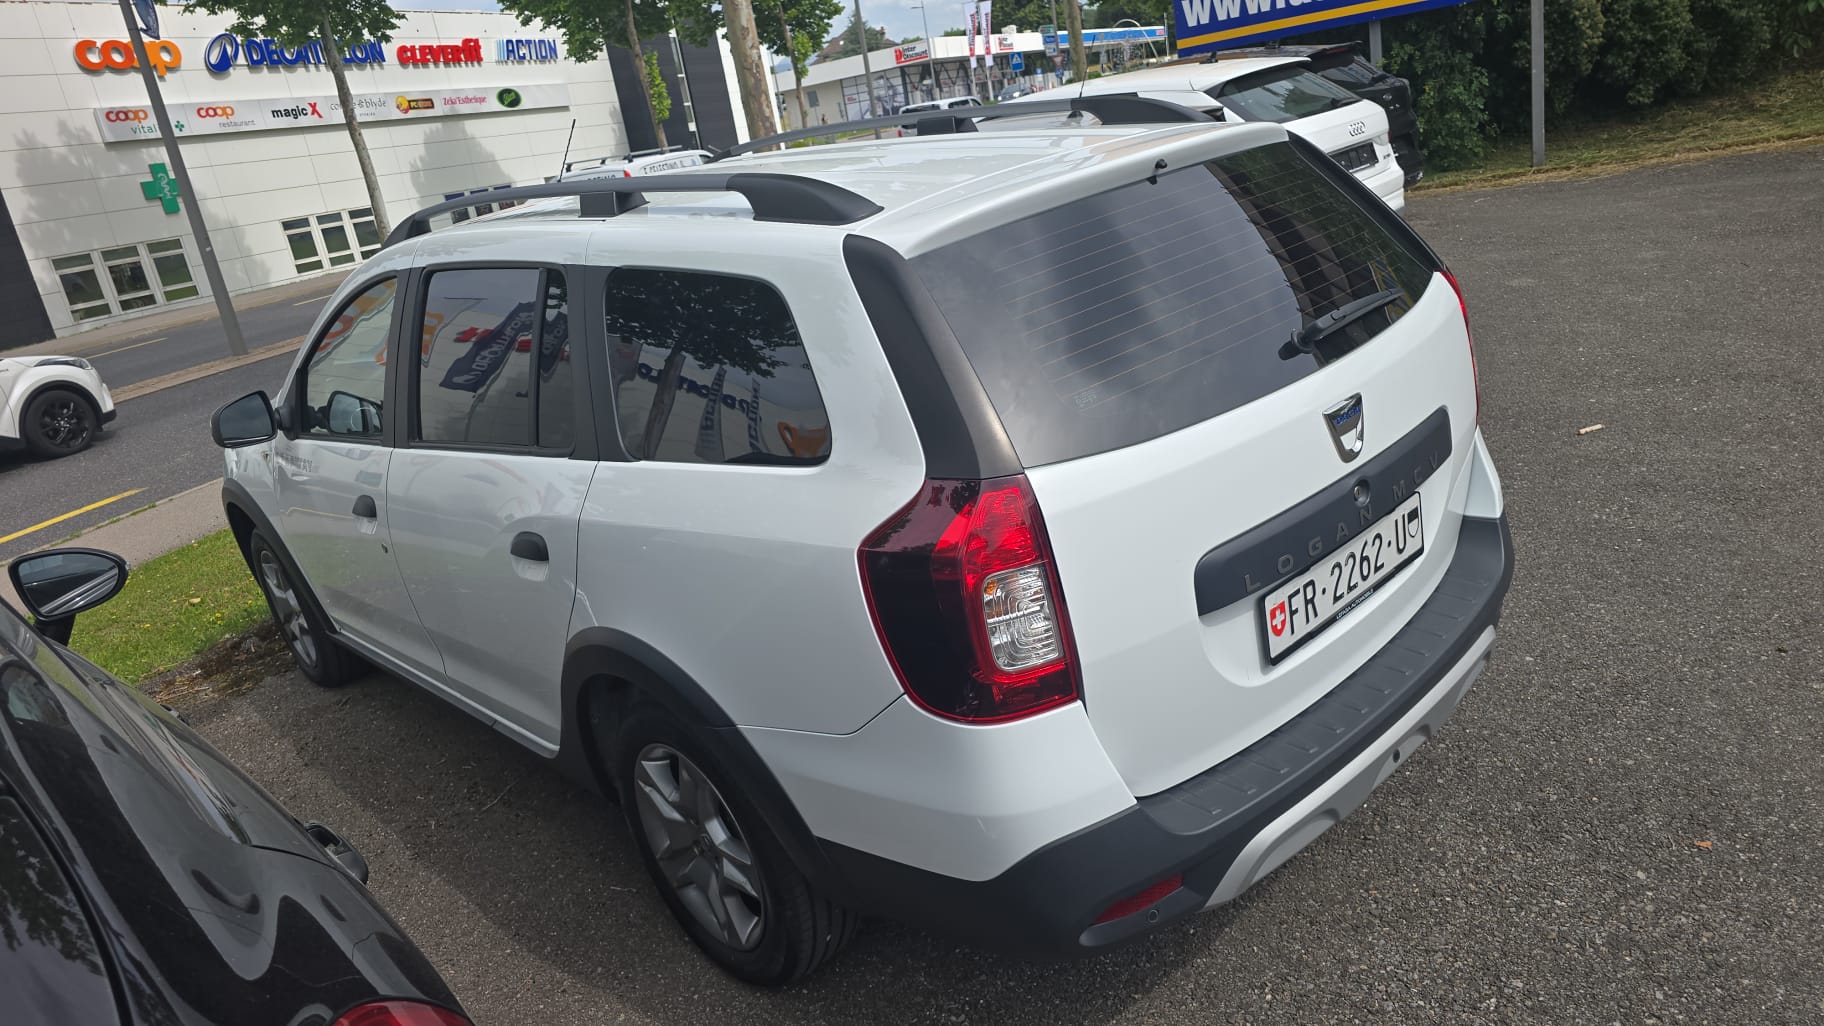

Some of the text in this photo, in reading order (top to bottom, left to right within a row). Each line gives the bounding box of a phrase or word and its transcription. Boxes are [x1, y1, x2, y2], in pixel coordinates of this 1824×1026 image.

[505, 39, 559, 61] ACTION
[105, 109, 148, 124] coop
[196, 106, 235, 119] coop
[218, 119, 256, 128] restaurant
[1244, 451, 1439, 593] LOGAN MCV
